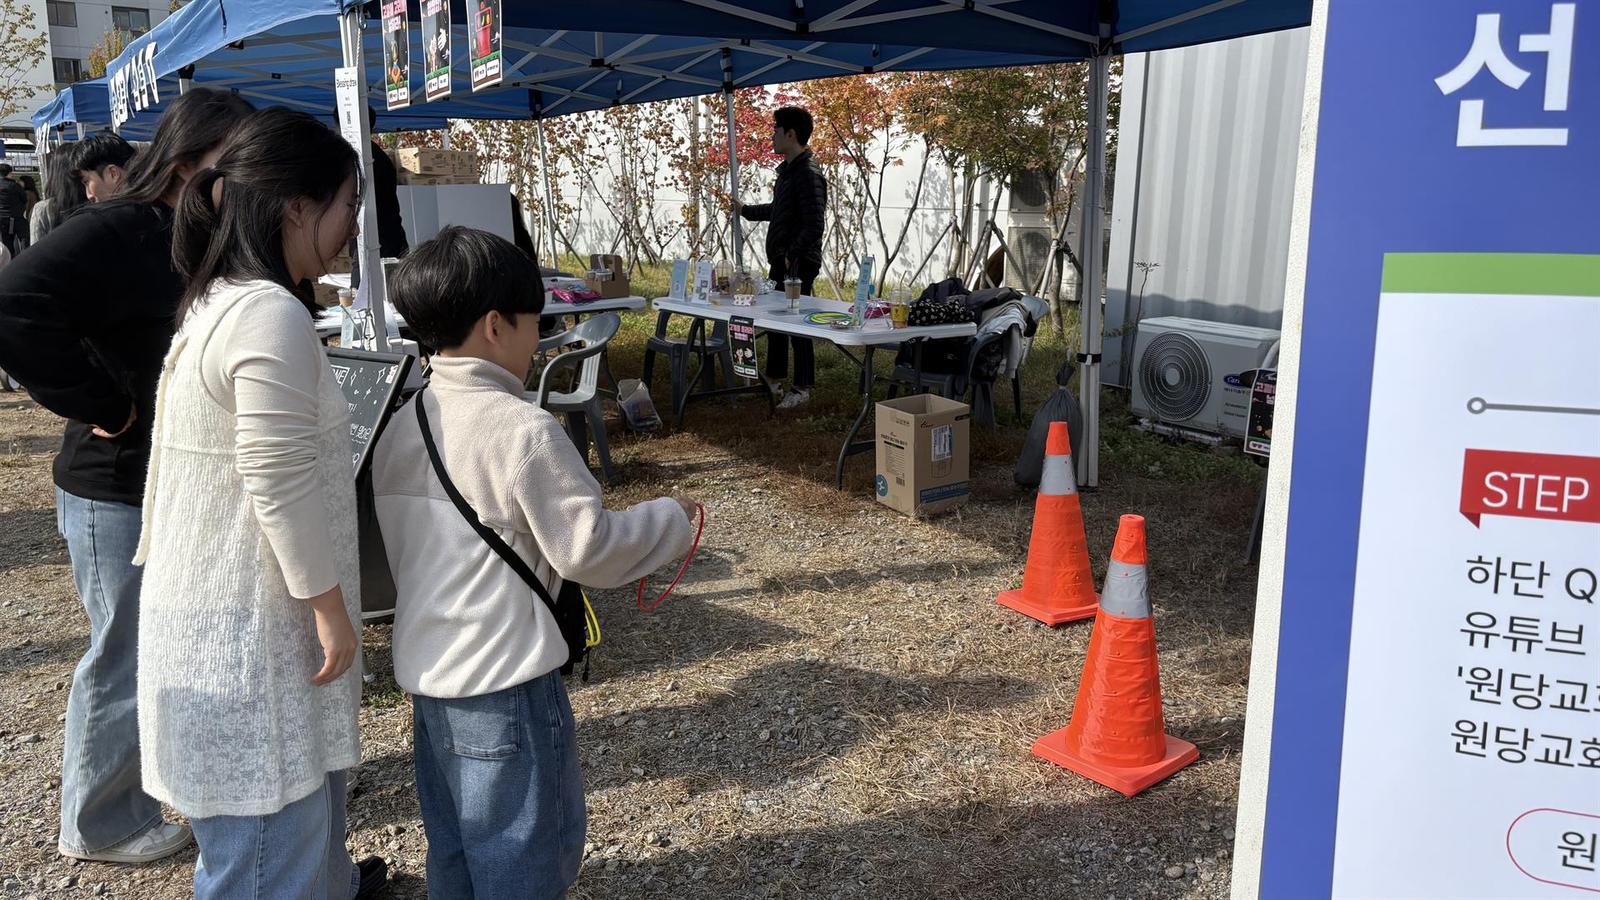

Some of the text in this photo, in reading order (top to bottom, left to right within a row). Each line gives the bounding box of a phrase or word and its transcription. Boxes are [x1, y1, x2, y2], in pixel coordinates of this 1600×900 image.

[1434, 3, 1576, 147] 선
[1482, 471, 1590, 513] STEP
[1466, 555, 1551, 598] 하단
[1460, 611, 1586, 655] 유튜브
[1457, 666, 1600, 713] '원당교
[1557, 831, 1598, 872] 원
